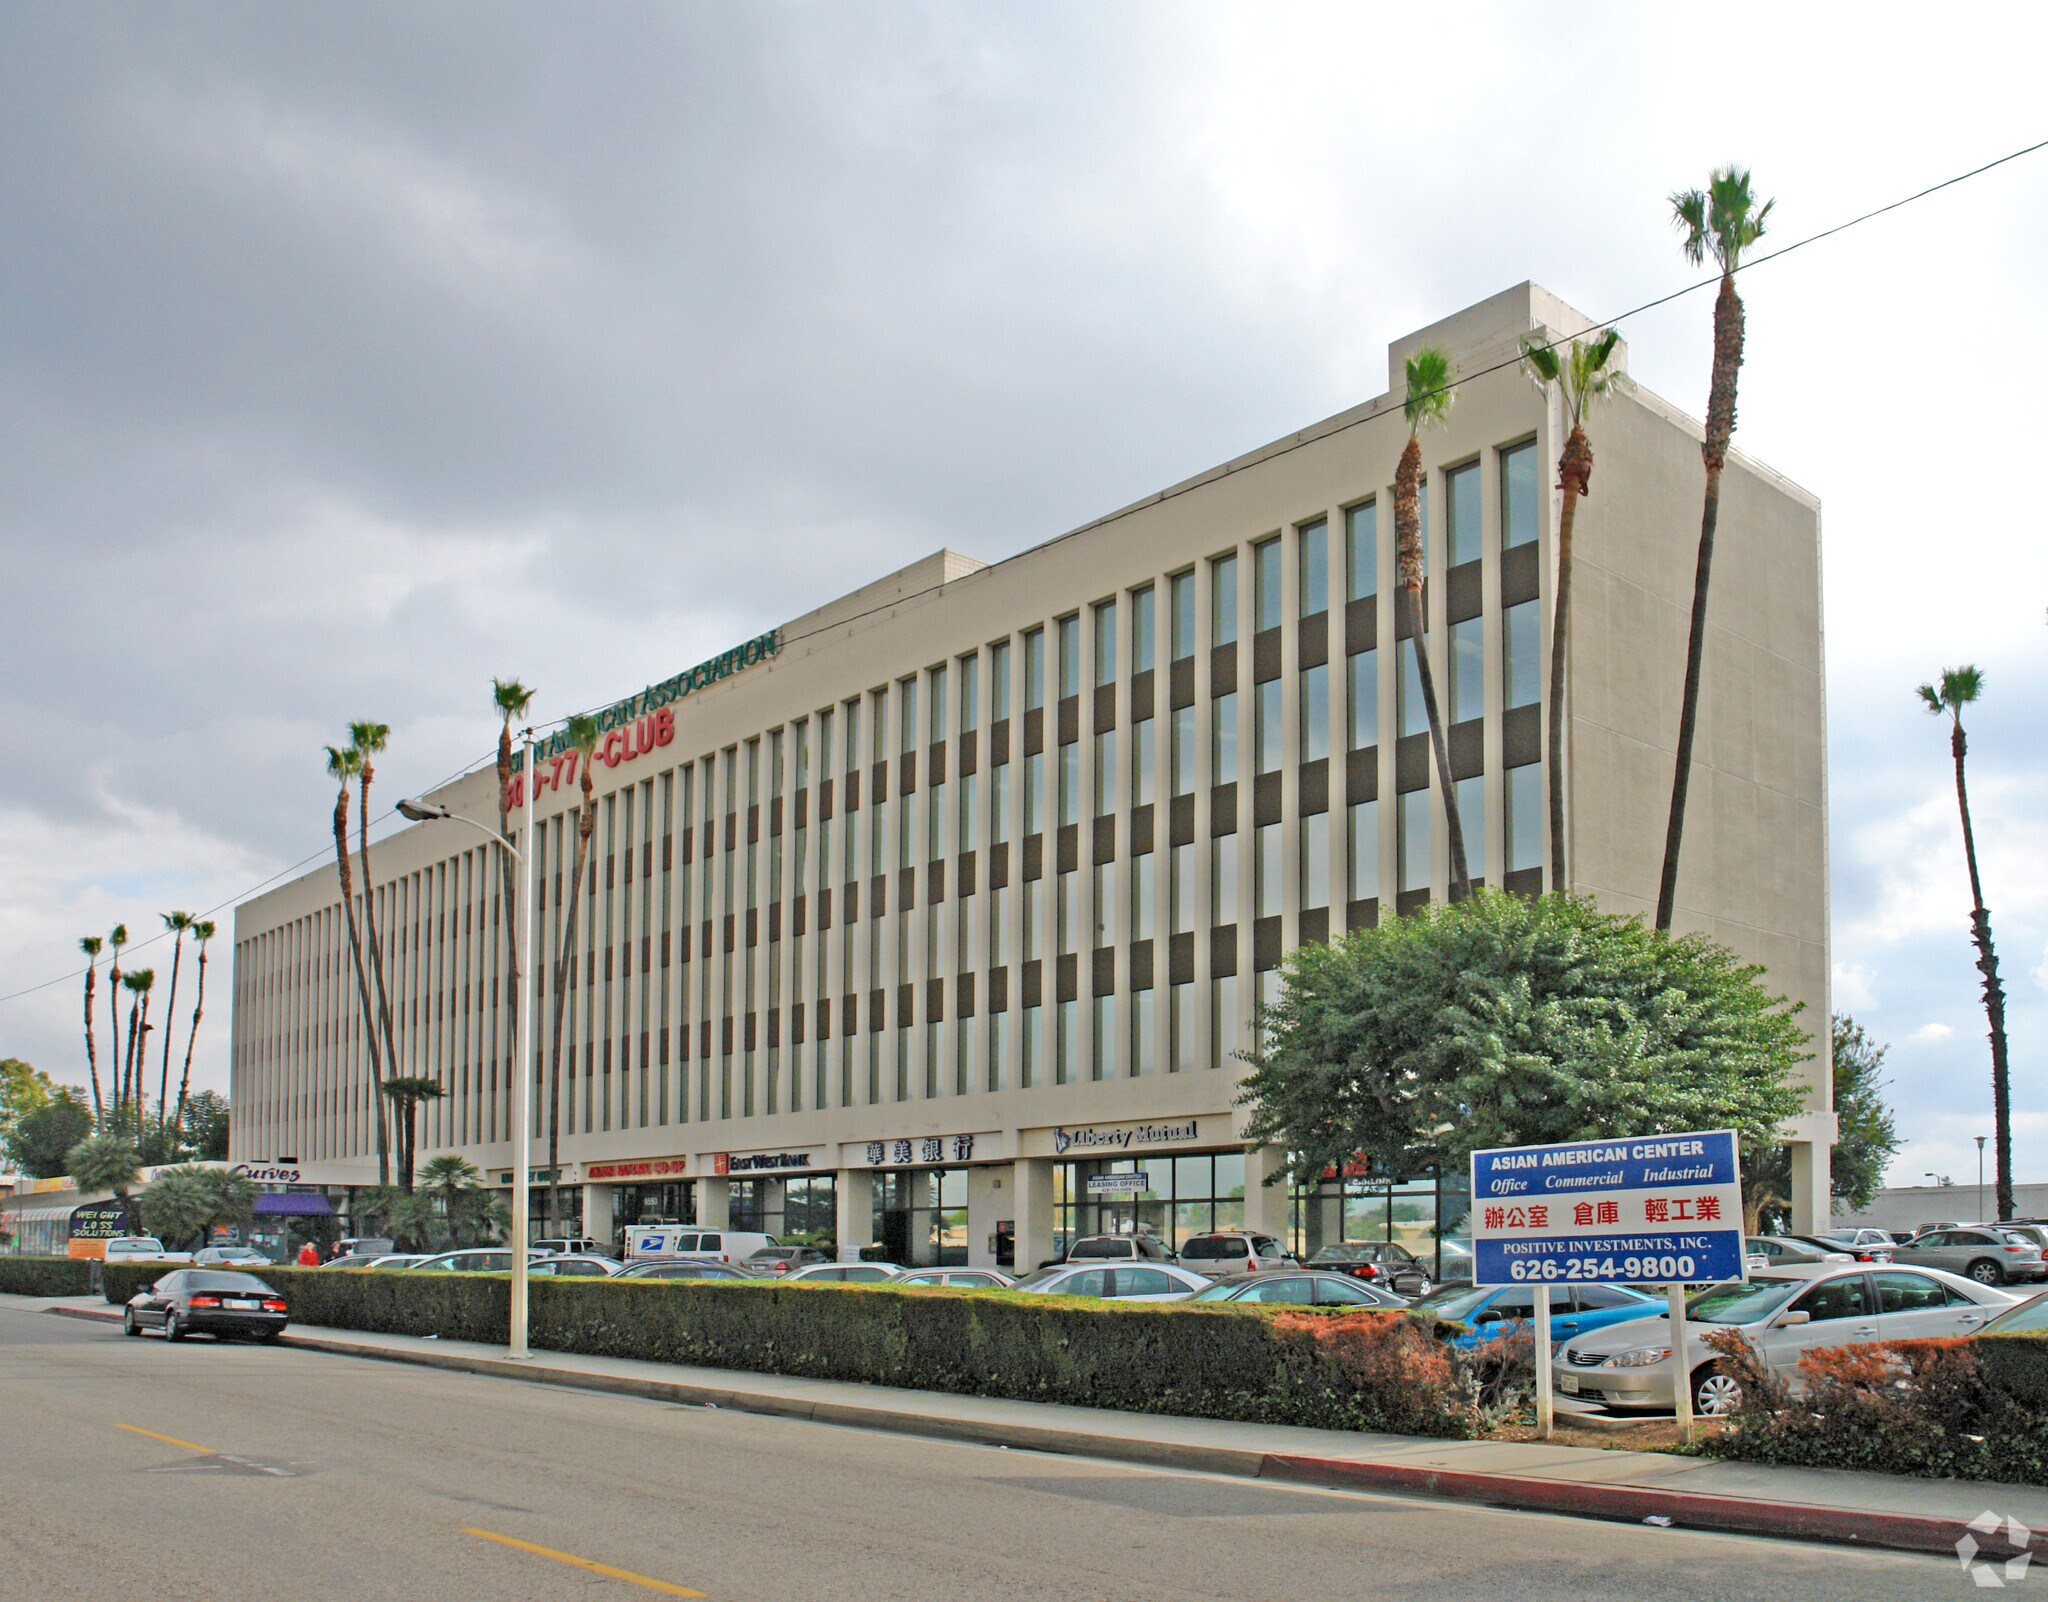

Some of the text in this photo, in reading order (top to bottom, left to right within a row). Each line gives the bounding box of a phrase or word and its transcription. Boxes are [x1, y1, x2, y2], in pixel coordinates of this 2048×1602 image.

[640, 630, 778, 714] ASSOCIATION
[1073, 1120, 1197, 1147] Liberty Mutual
[867, 1135, 973, 1165] 華美銀行
[1491, 1140, 1704, 1171] ASIAN AMERICAN CENTER
[1491, 1164, 1714, 1195] Office Commercial Industrial
[1485, 1196, 1721, 1229] 辦公室 倉庫 輕工業
[73, 1229, 125, 1237] SOLUTIONS
[1503, 1236, 1712, 1254] POSITIVE INVESTMENTS, INC.
[1510, 1255, 1695, 1280] 626-254-9800
